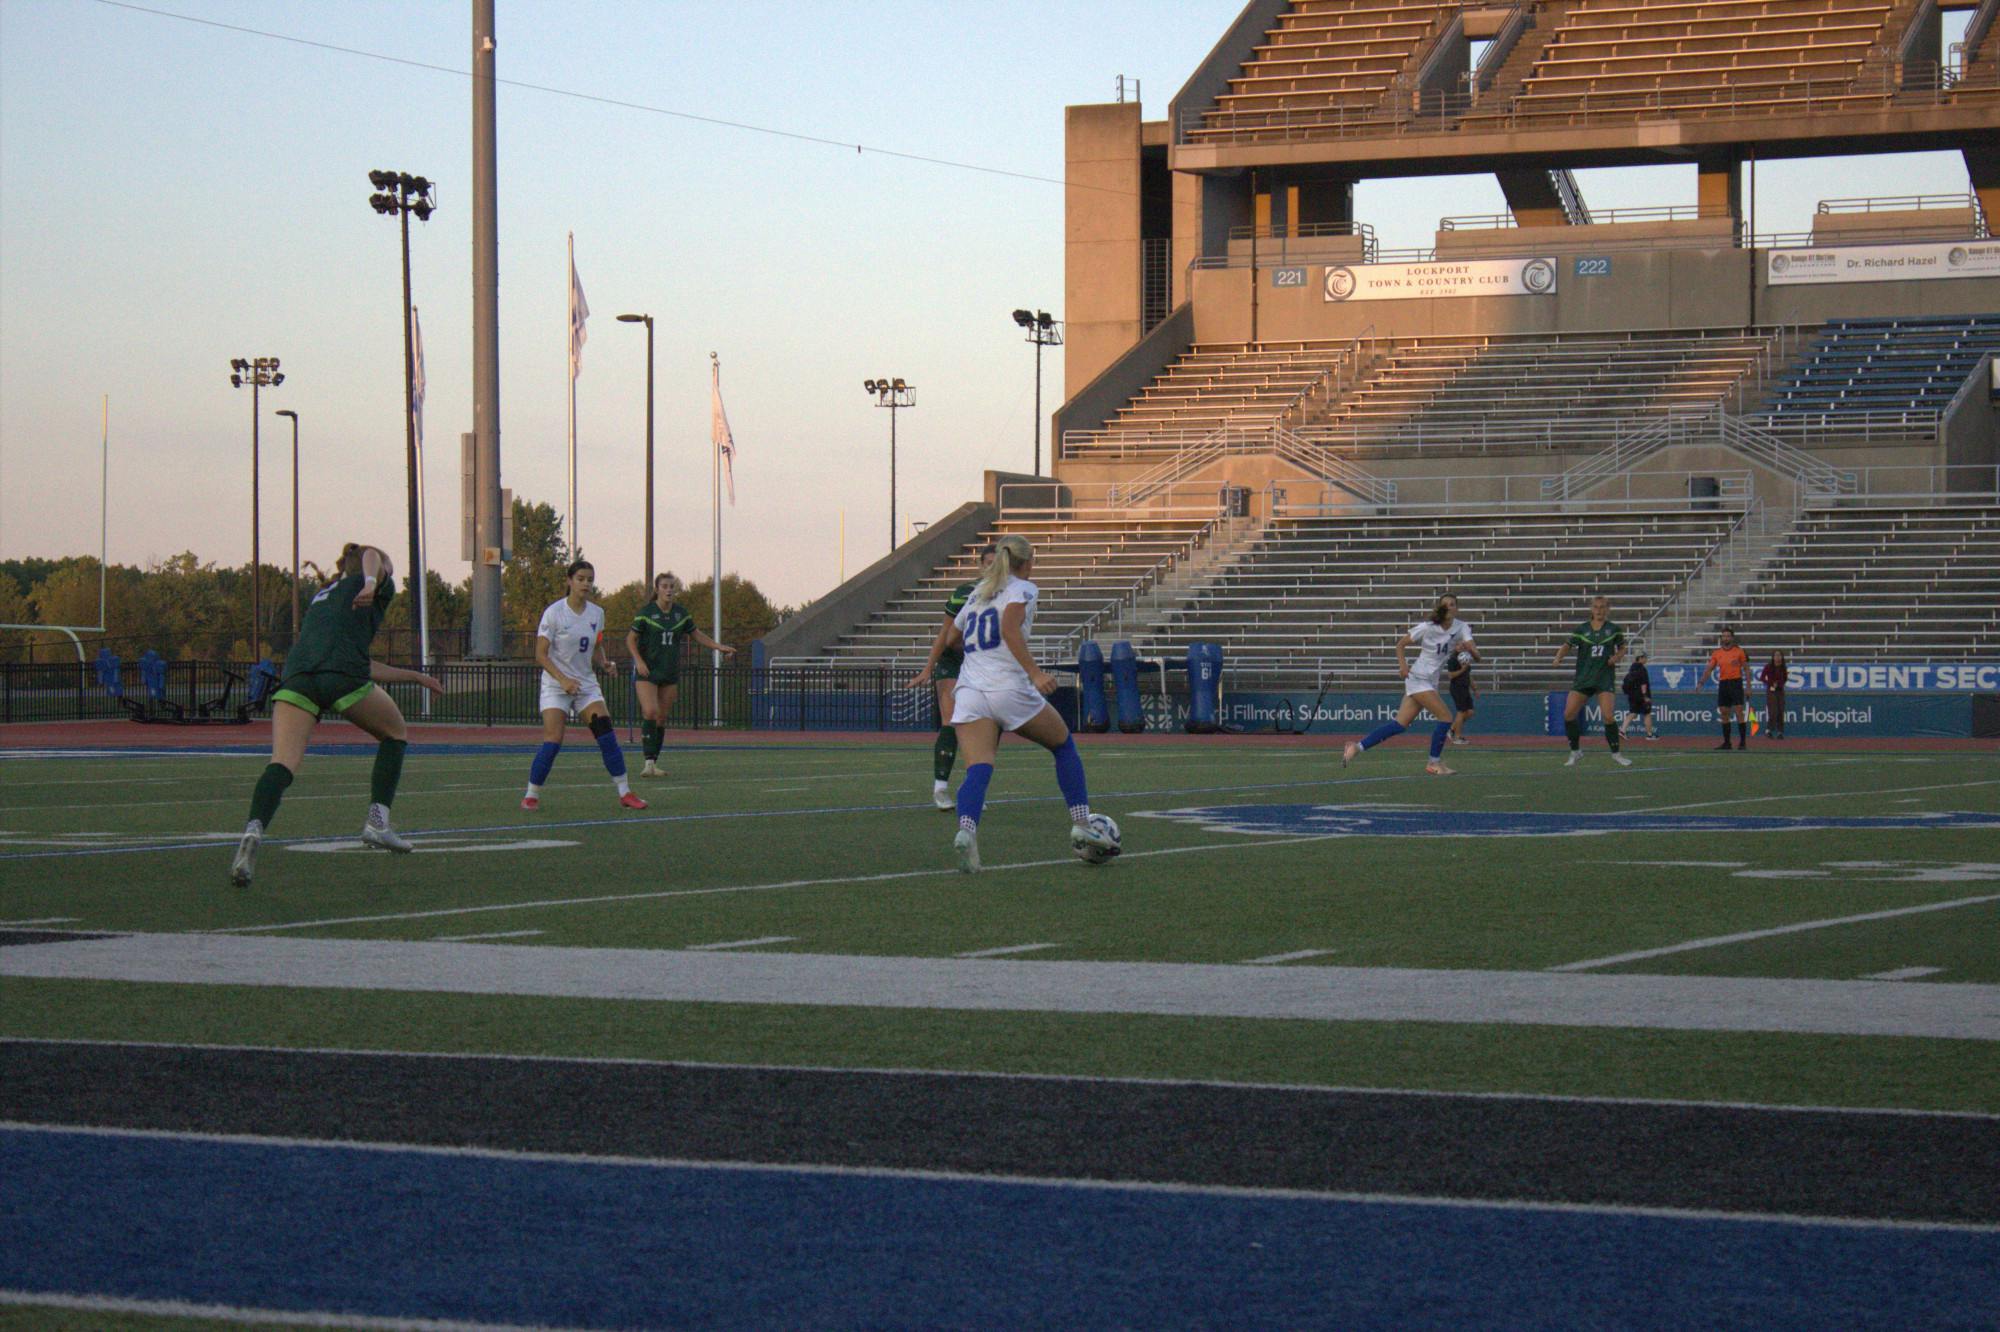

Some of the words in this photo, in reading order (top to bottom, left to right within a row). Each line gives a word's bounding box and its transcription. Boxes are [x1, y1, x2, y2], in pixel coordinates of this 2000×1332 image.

[1578, 259, 1607, 275] 222
[1847, 259, 1862, 268] Dr.
[1864, 256, 1905, 267] Richard
[1907, 255, 1937, 266] Hazel
[1277, 271, 1302, 285] 221
[1407, 265, 1470, 276] LOCKPORT
[1368, 279, 1400, 288] TOWN
[1406, 279, 1413, 287] &
[1418, 276, 1474, 286] COUNTRY
[1479, 275, 1510, 284] CLUB
[661, 631, 673, 646] 17
[964, 607, 1001, 655] 20
[579, 636, 590, 653] 9
[1436, 643, 1449, 656] 14
[1591, 645, 1604, 657] 27
[1785, 665, 1931, 689] STUDENT
[1936, 665, 2000, 689] SEC
[1233, 703, 1295, 721] Fillmore
[1298, 703, 1373, 721] Suburban
[1802, 706, 1872, 729] Hospital
